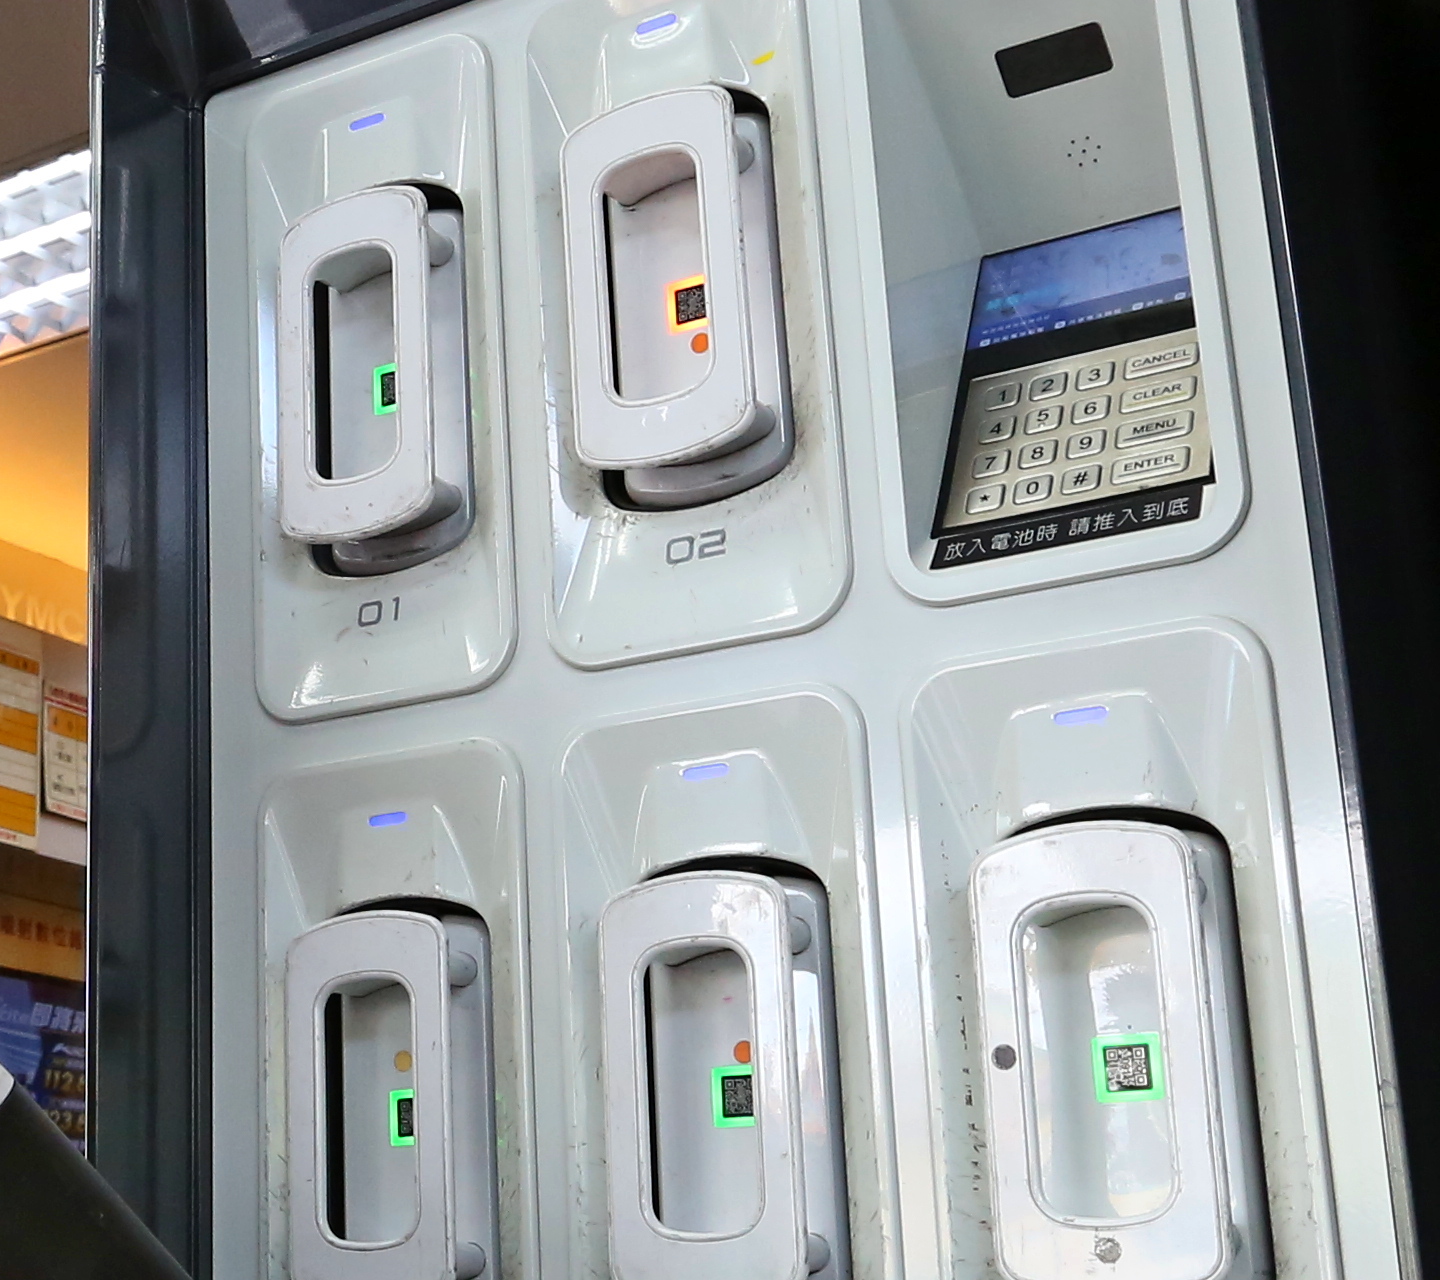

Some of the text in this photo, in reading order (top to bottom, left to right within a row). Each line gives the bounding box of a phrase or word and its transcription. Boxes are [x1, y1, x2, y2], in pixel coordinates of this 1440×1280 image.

[998, 348, 1191, 402] 1 2 3 CANCEL
[989, 382, 1183, 435] 4 5 6 CLEAR
[984, 418, 1177, 470] 7 8 9 MENU
[1026, 481, 1039, 495] 0
[1123, 453, 1175, 472] ENTER
[943, 496, 1191, 562] 放入電池時 請推入到底
[357, 530, 727, 627] 01 02
